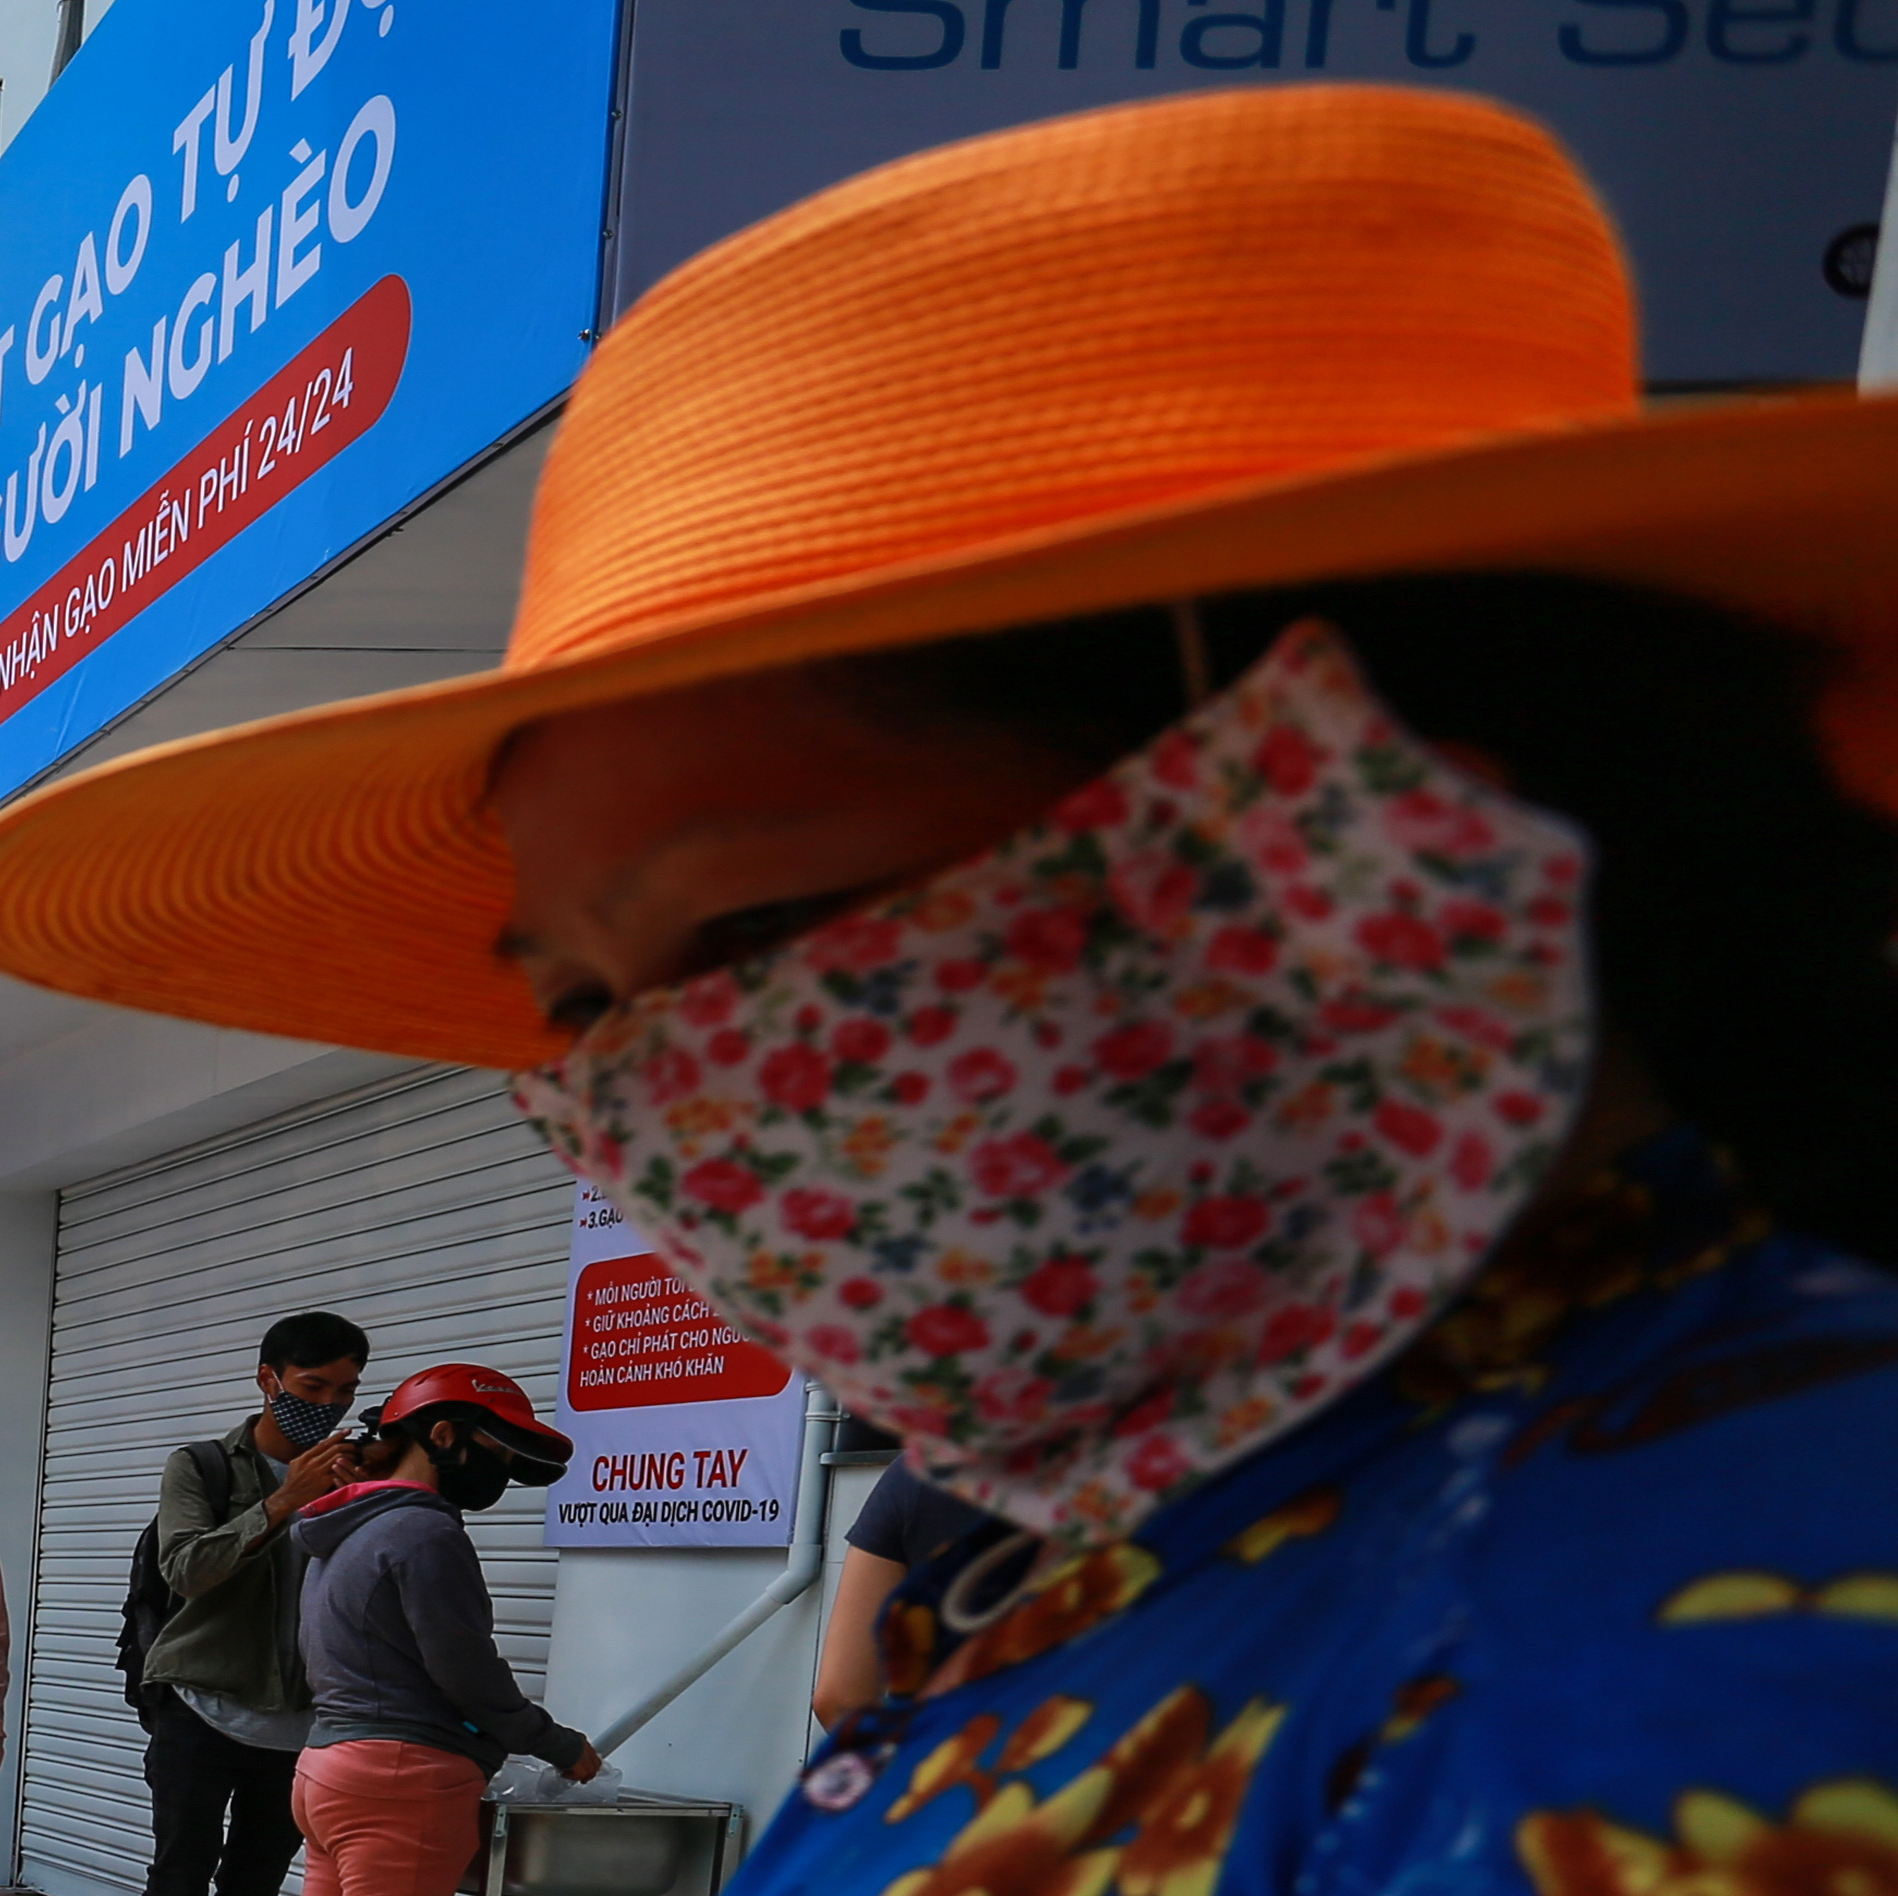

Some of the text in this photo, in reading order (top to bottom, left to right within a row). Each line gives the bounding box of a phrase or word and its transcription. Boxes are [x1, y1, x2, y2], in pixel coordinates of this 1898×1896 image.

[25, 173, 153, 386] GẠO
[172, 0, 276, 224] TỰ
[119, 94, 397, 459] NGHÈO
[64, 557, 117, 638] GẠO
[121, 487, 192, 593] MIỄN
[197, 418, 253, 530] PHÍ
[257, 346, 355, 480] 24/24
[594, 1281, 619, 1306] MỖI
[621, 1276, 662, 1302] NGƯỜI
[592, 1310, 615, 1333] GIỮ
[617, 1303, 670, 1329] KHOẢNG
[672, 1299, 710, 1323] CÁCH
[590, 1342, 616, 1362] GẠO
[618, 1334, 641, 1356] CHỈ
[642, 1329, 678, 1352] PHÁT
[683, 1329, 710, 1348] CHO
[579, 1352, 725, 1388] HOÀN CẢNH KHÓ KHĂN
[591, 1448, 749, 1493] CHUNG TAY
[558, 1497, 779, 1529] VƯỢT QUA ĐẠI DỊCH COVID-19
